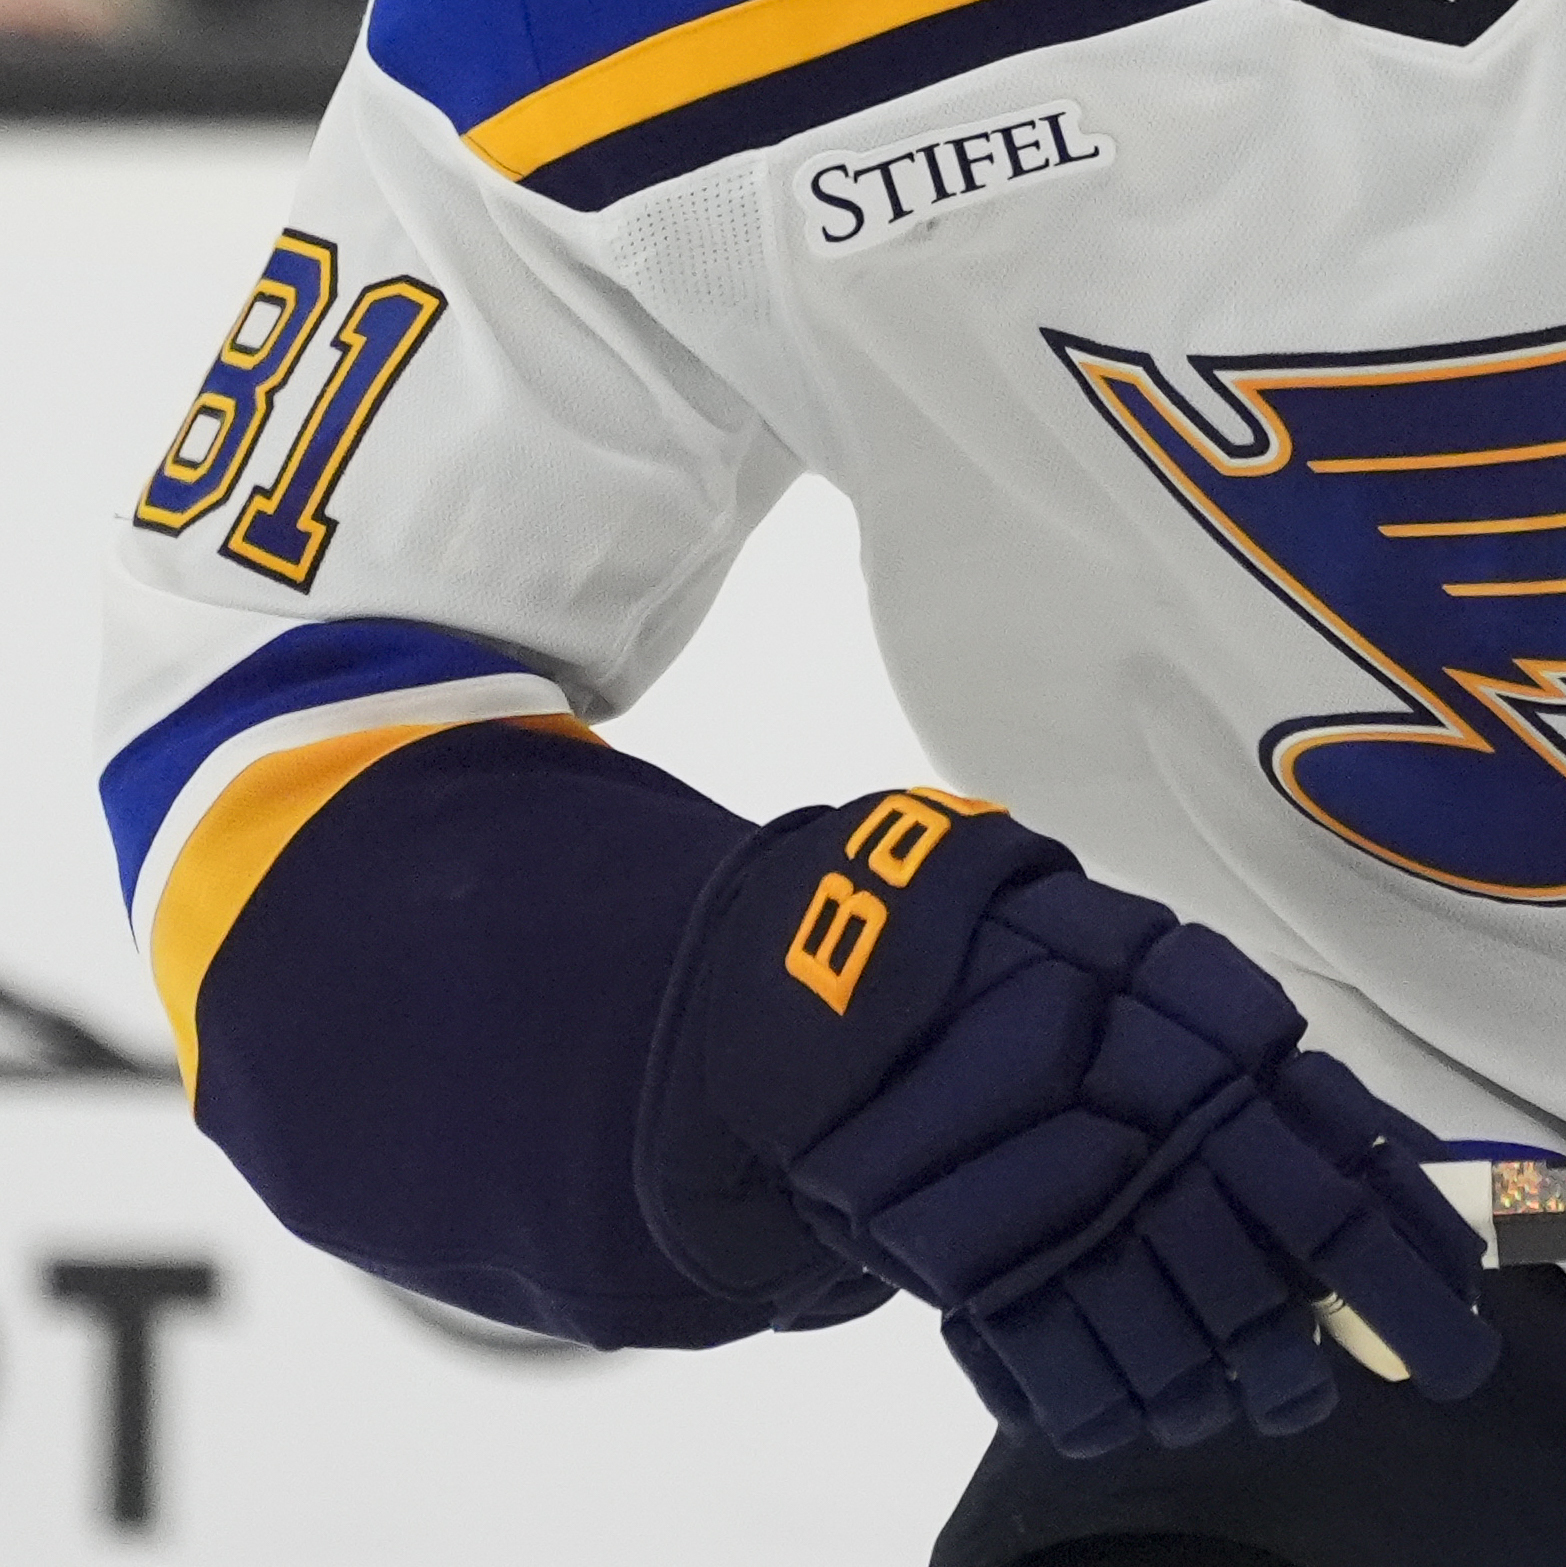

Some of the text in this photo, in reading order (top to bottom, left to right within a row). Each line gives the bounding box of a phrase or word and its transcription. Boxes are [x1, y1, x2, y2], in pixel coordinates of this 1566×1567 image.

[810, 111, 1100, 243] STIFEL
[132, 227, 448, 595] 81
[0, 1254, 216, 1530] T
